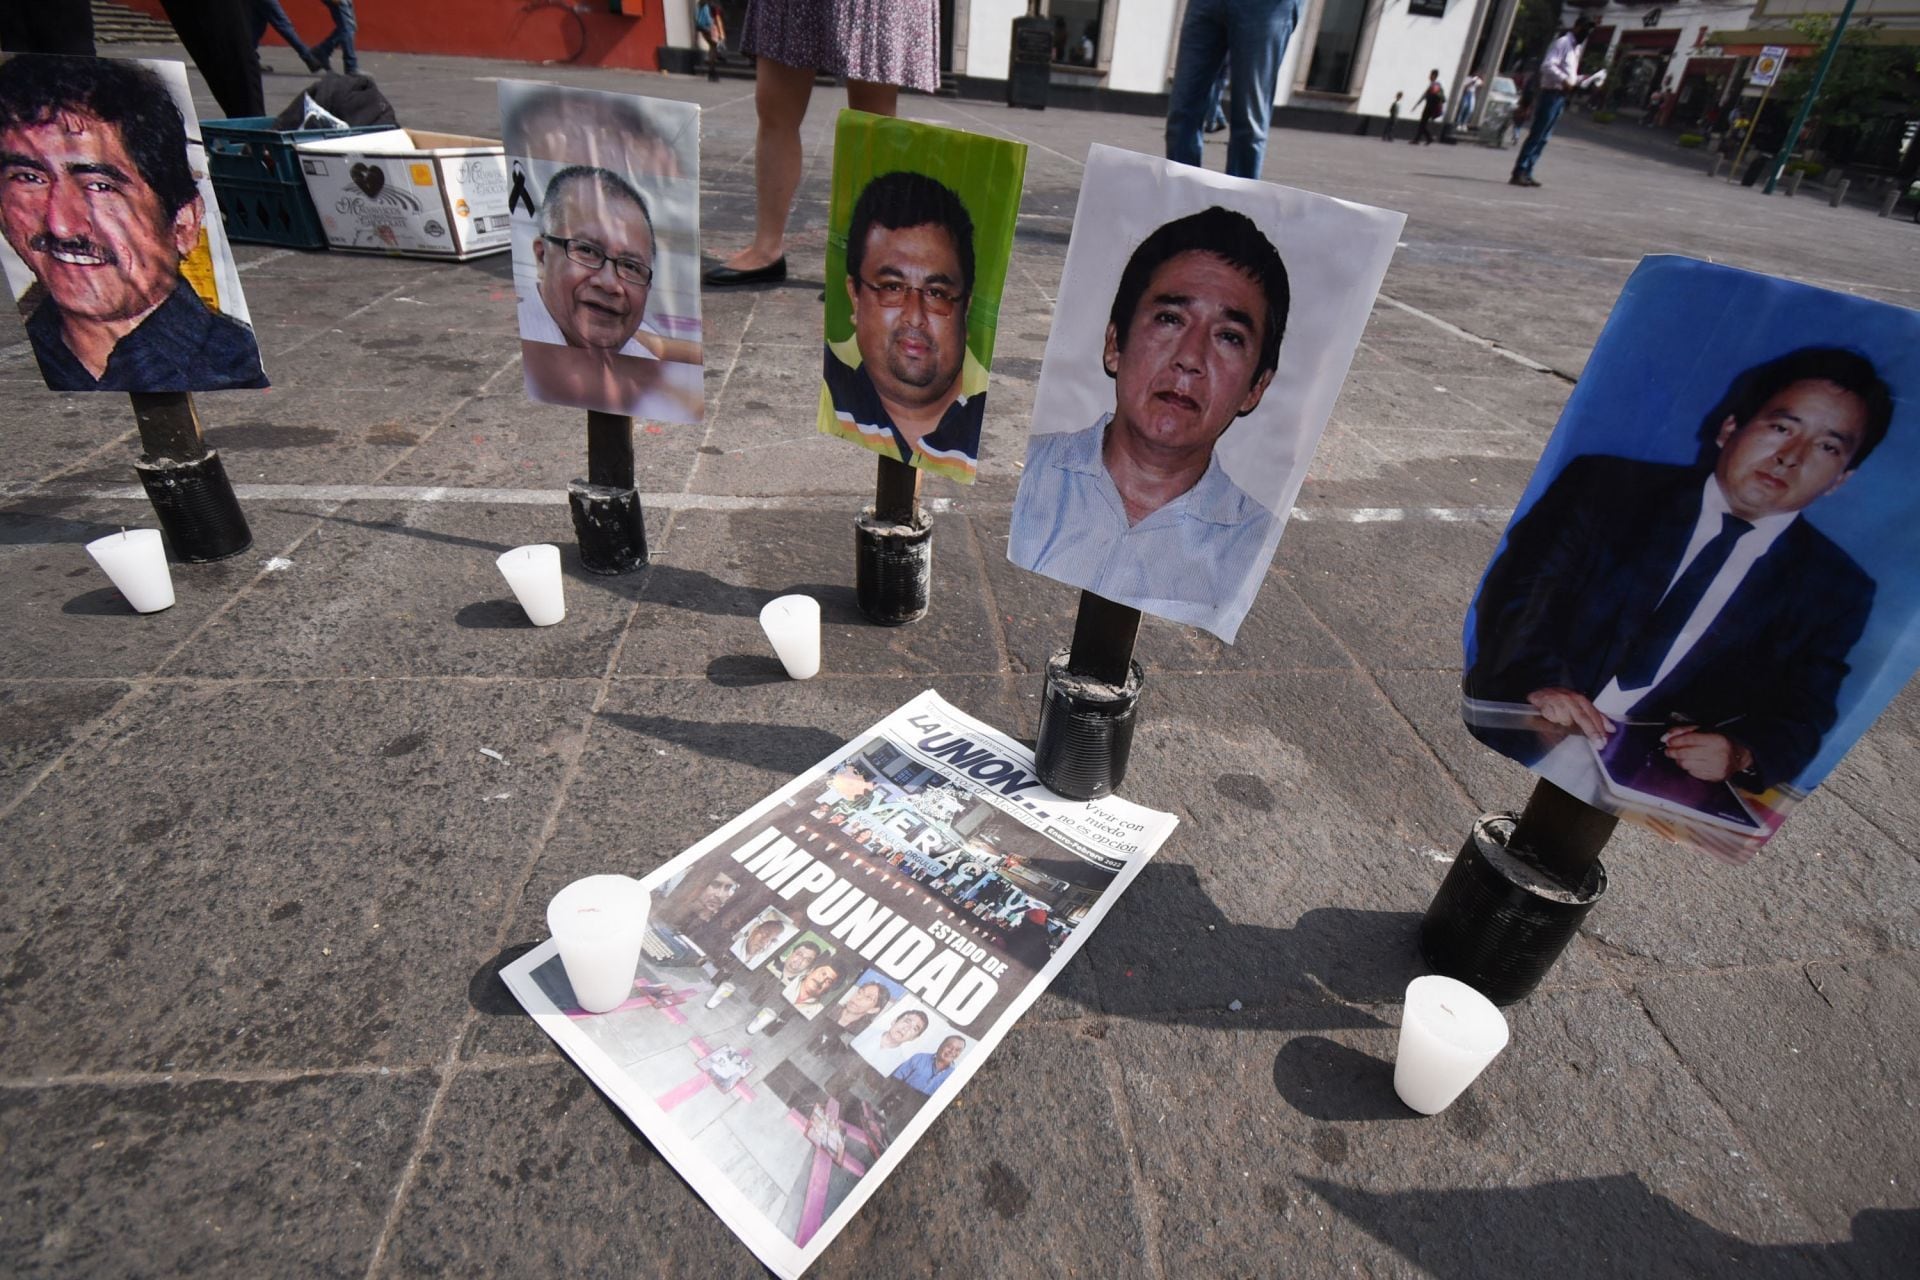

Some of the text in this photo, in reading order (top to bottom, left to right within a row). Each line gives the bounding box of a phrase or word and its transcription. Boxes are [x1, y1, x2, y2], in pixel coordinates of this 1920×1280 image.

[907, 714, 942, 735] LA
[937, 766, 953, 780] La
[954, 776, 974, 789] voz
[974, 786, 992, 798] de
[1057, 814, 1076, 826] no
[1076, 825, 1091, 835] es
[1084, 816, 1126, 838] miedo
[1085, 802, 1145, 832] Vivir con
[904, 848, 940, 873] ORGULLO
[1047, 827, 1123, 869] Enero-Febrero 2022
[730, 825, 1000, 1027] IMPUNIDAD
[927, 919, 1009, 979] ESTADO DE
